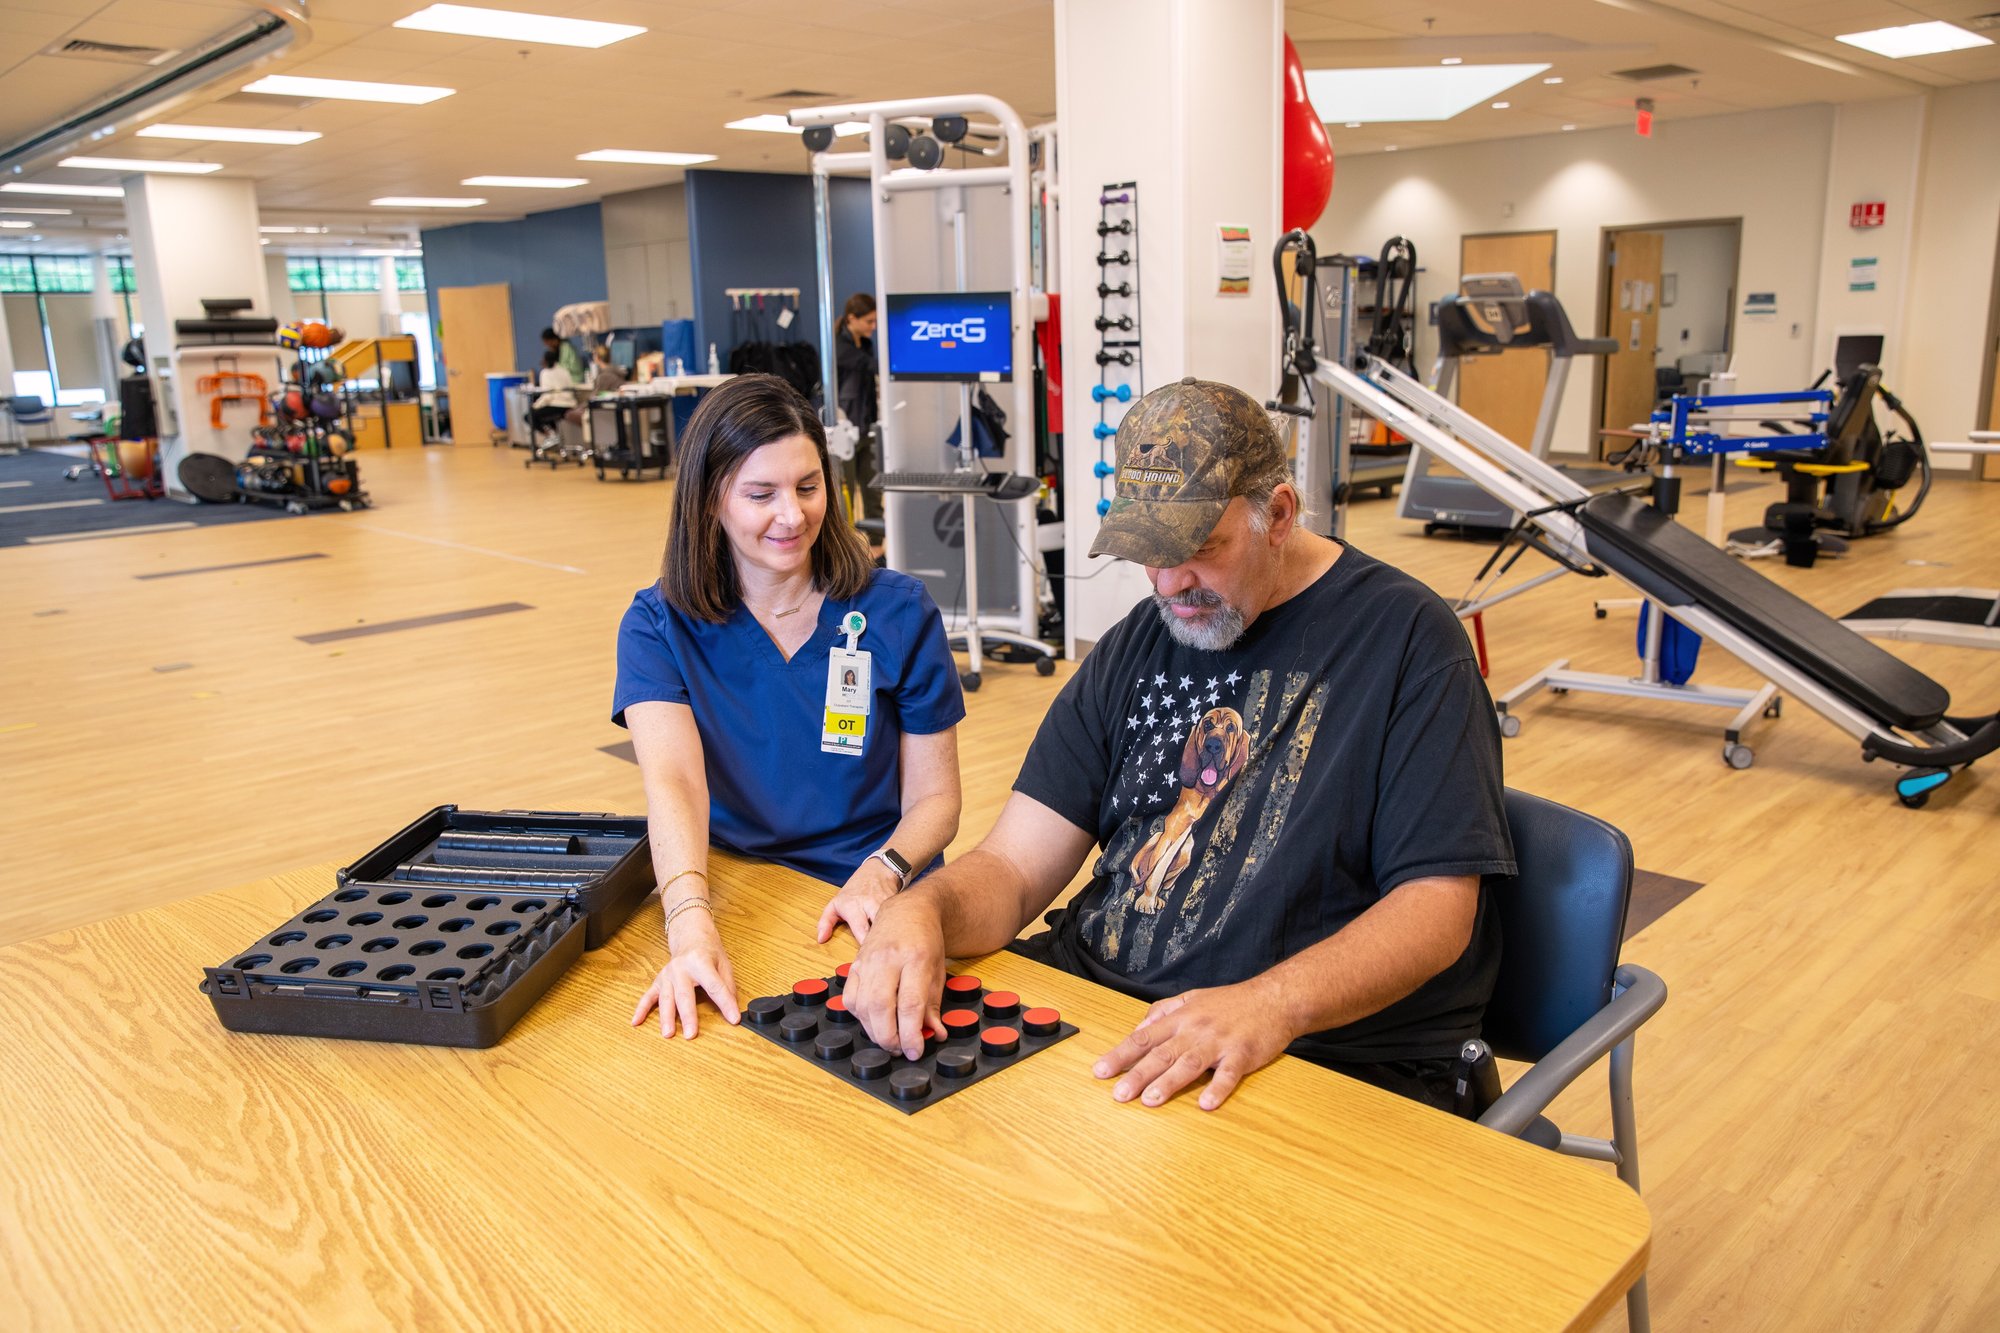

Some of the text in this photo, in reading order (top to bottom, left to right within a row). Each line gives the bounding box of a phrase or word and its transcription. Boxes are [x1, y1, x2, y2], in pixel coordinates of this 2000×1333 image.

[911, 318, 986, 343] ZeroG
[1143, 472, 1181, 483] HOUND
[842, 686, 857, 694] Mary
[838, 719, 856, 731] OT
